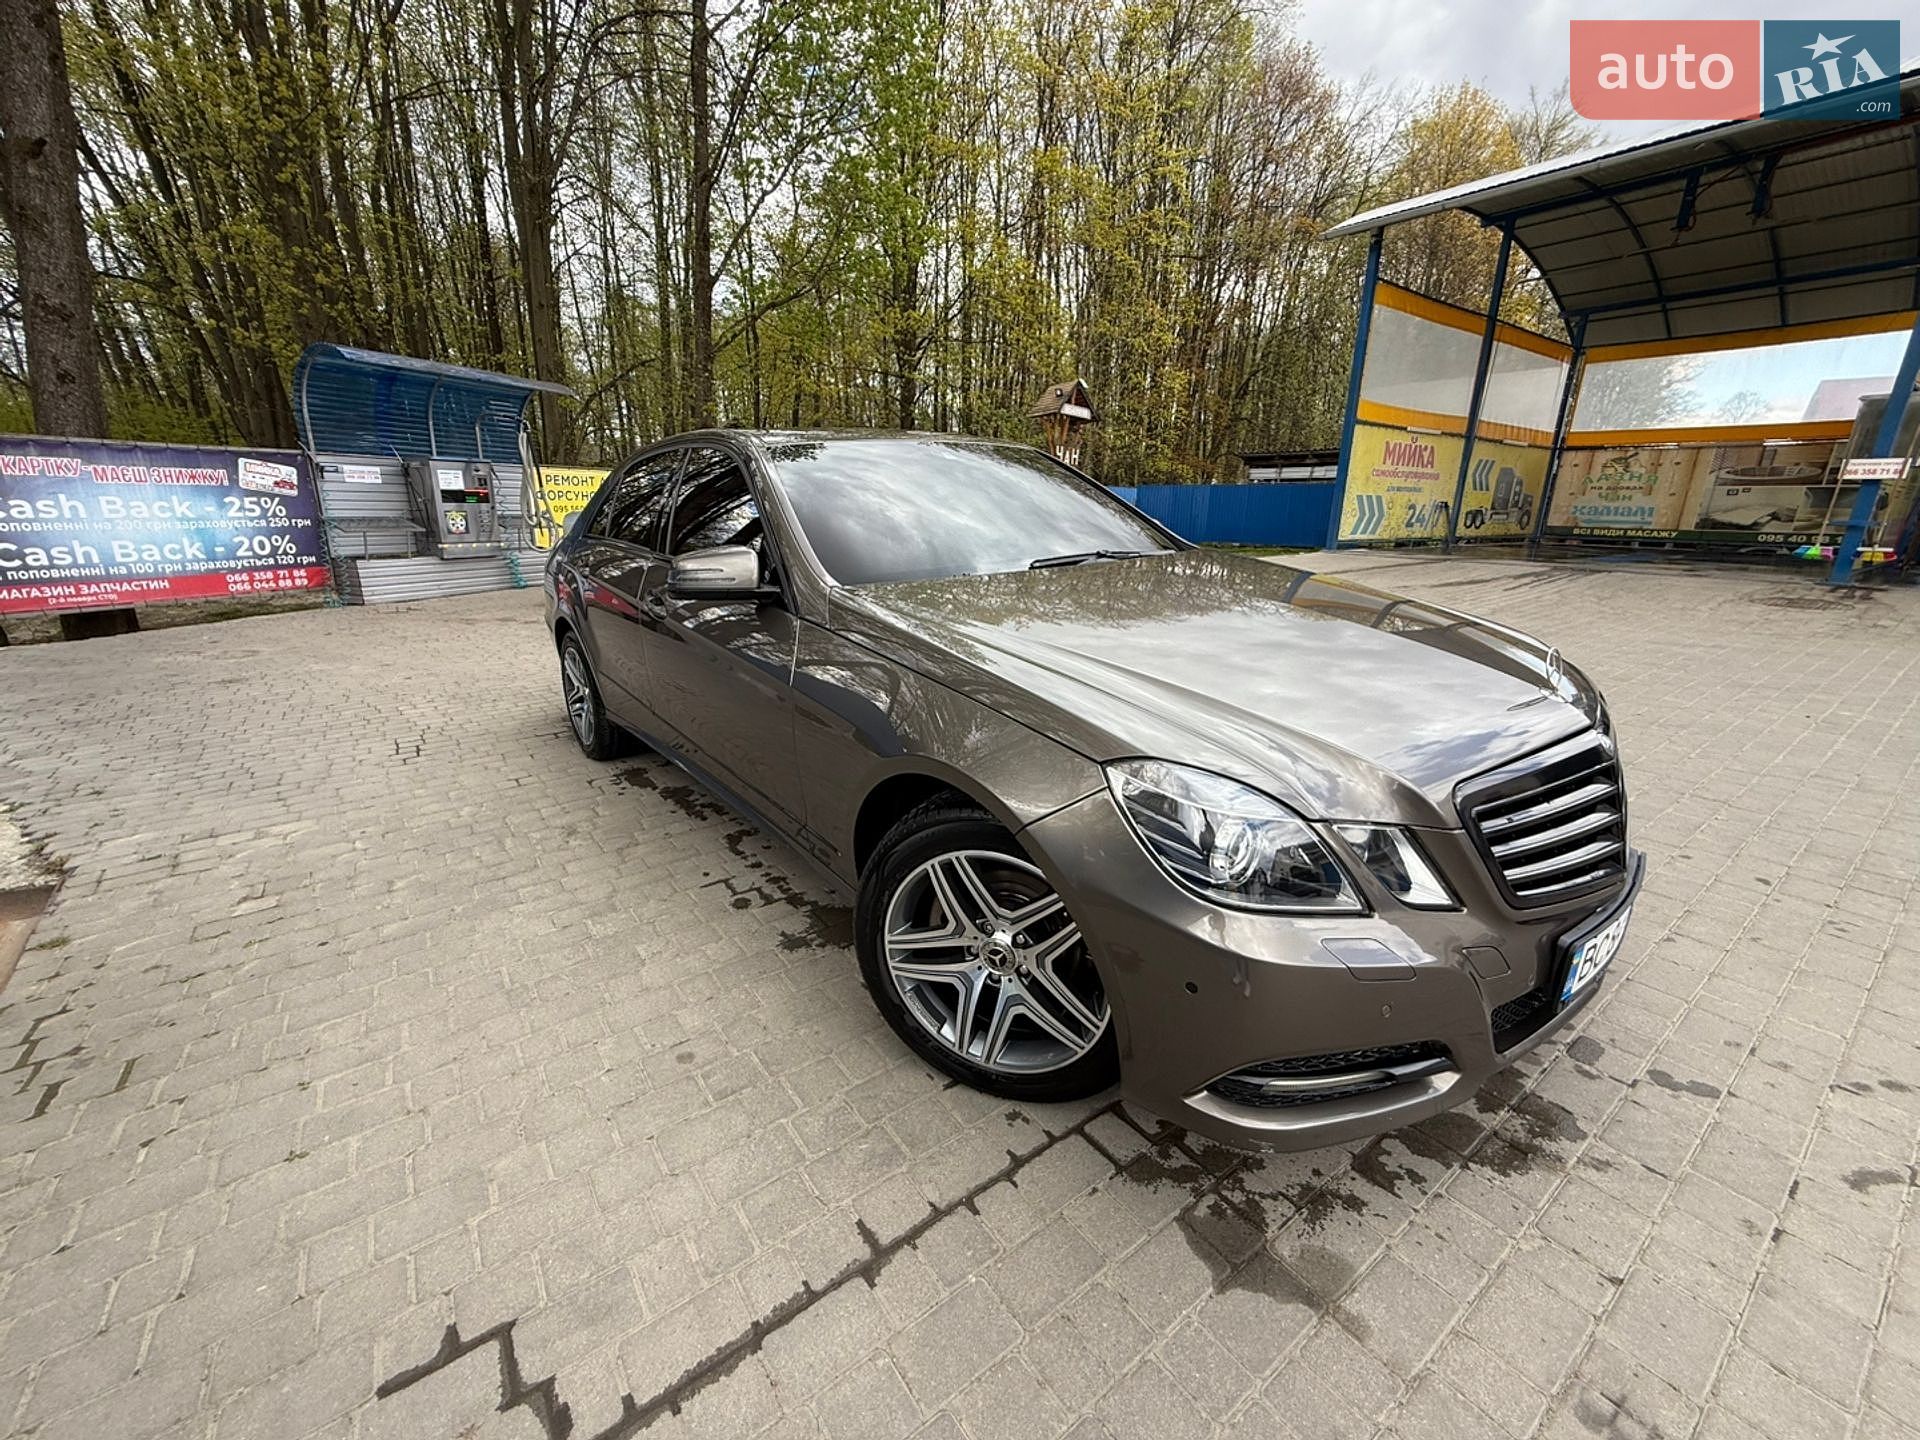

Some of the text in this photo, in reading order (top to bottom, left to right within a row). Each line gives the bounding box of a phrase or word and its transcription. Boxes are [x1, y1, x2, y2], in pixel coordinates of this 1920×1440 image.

[1056, 445, 1080, 465] ЧАН
[1382, 436, 1436, 469] МИЙКА
[0, 455, 80, 477] КАРТКУ
[90, 465, 149, 484] МАЄШ
[149, 466, 229, 486] ЗНИЖКУ!
[545, 474, 595, 487] РЕМОНТ
[98, 494, 196, 519] Back
[223, 496, 287, 518] 25%
[268, 518, 289, 528] 250
[291, 518, 311, 529] грн
[1626, 529, 1679, 538] МАСАЖУ
[1757, 534, 1785, 543] 095
[1787, 535, 1807, 543] 40
[0, 540, 100, 568] Cash
[111, 537, 207, 562] Back
[232, 535, 296, 556] 20%
[7, 555, 316, 580] поповненні на 100 грн зараховується 120 грн
[0, 580, 170, 600] МАГАЗИН ЗАПЧАСТИН
